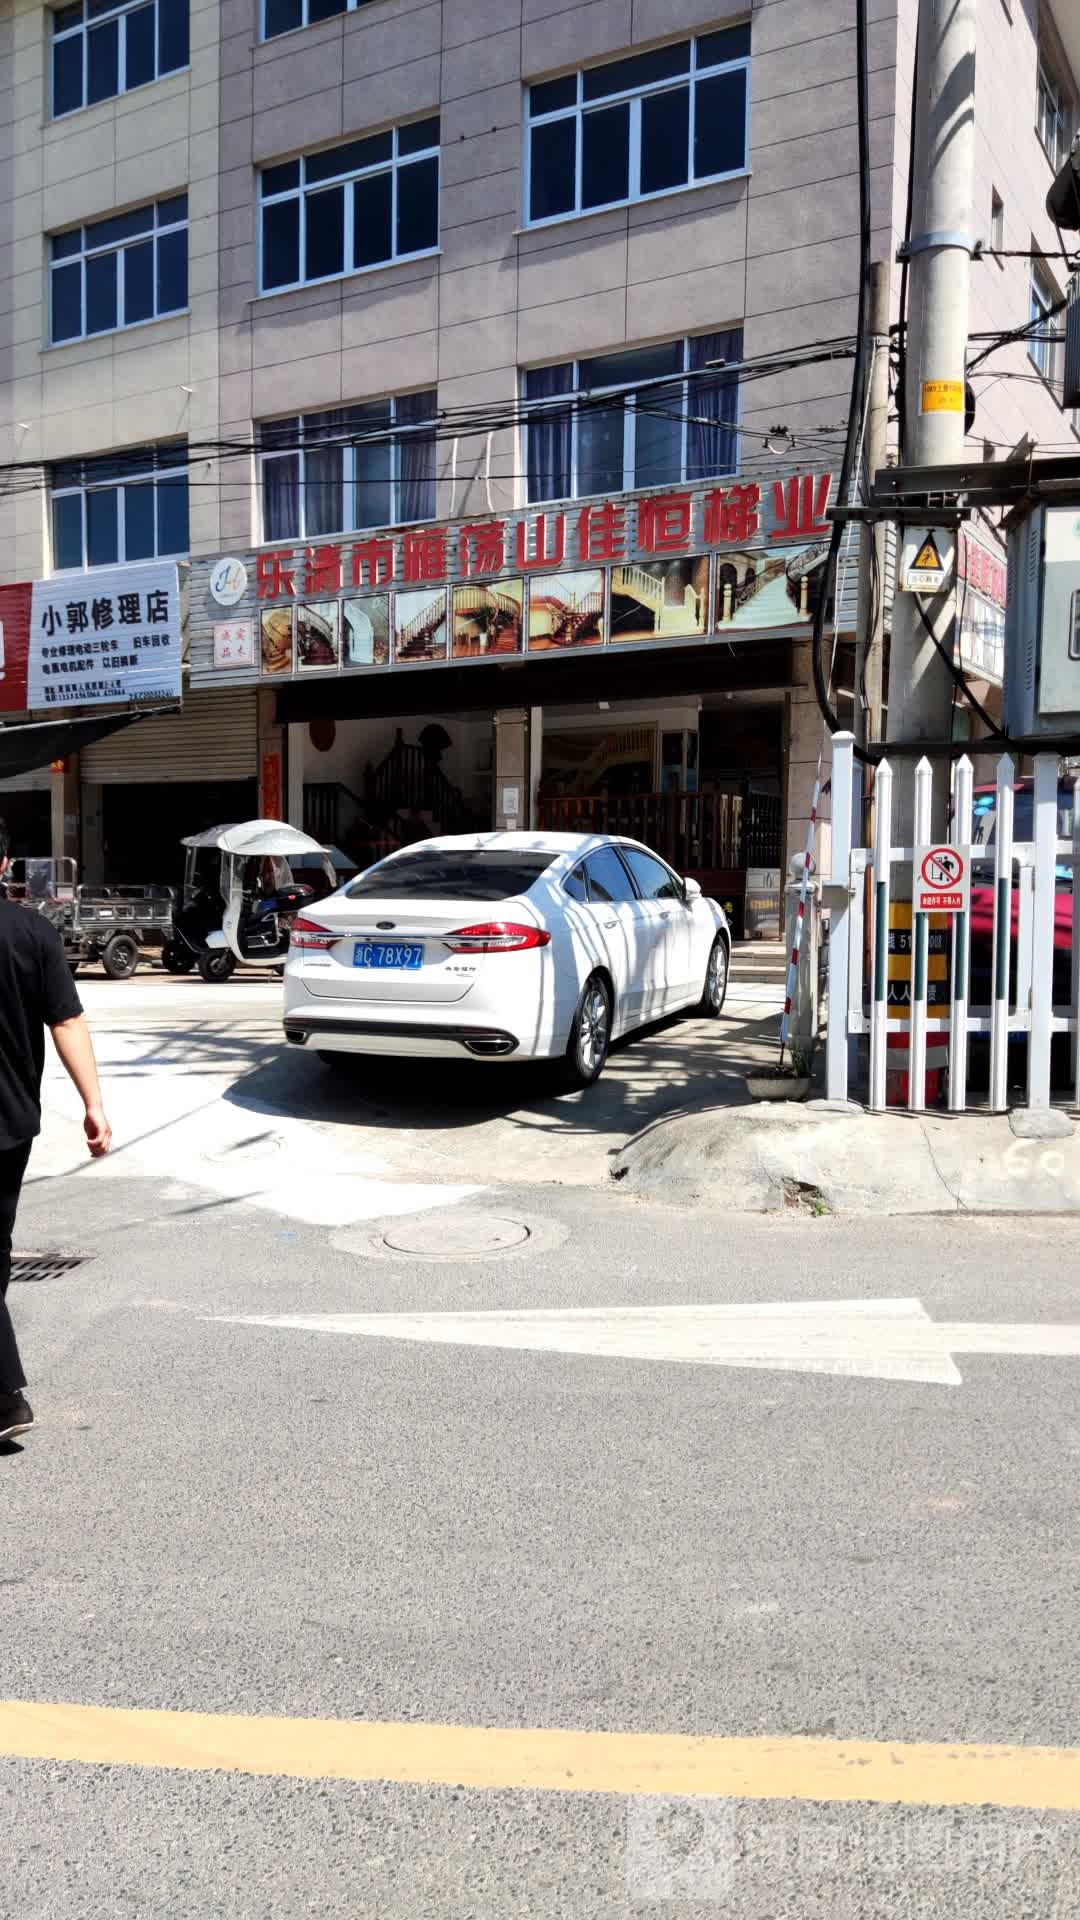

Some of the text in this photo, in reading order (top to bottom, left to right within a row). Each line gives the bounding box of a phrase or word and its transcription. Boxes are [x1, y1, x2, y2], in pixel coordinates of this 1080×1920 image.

[255, 470, 833, 600] 乐清市雁荡山佳恒梯业
[41, 590, 169, 637] 小郭修理店
[133, 634, 170, 649] 旧车回收
[102, 654, 138, 669] 以旧换新
[887, 983, 938, 1002] 人人责
